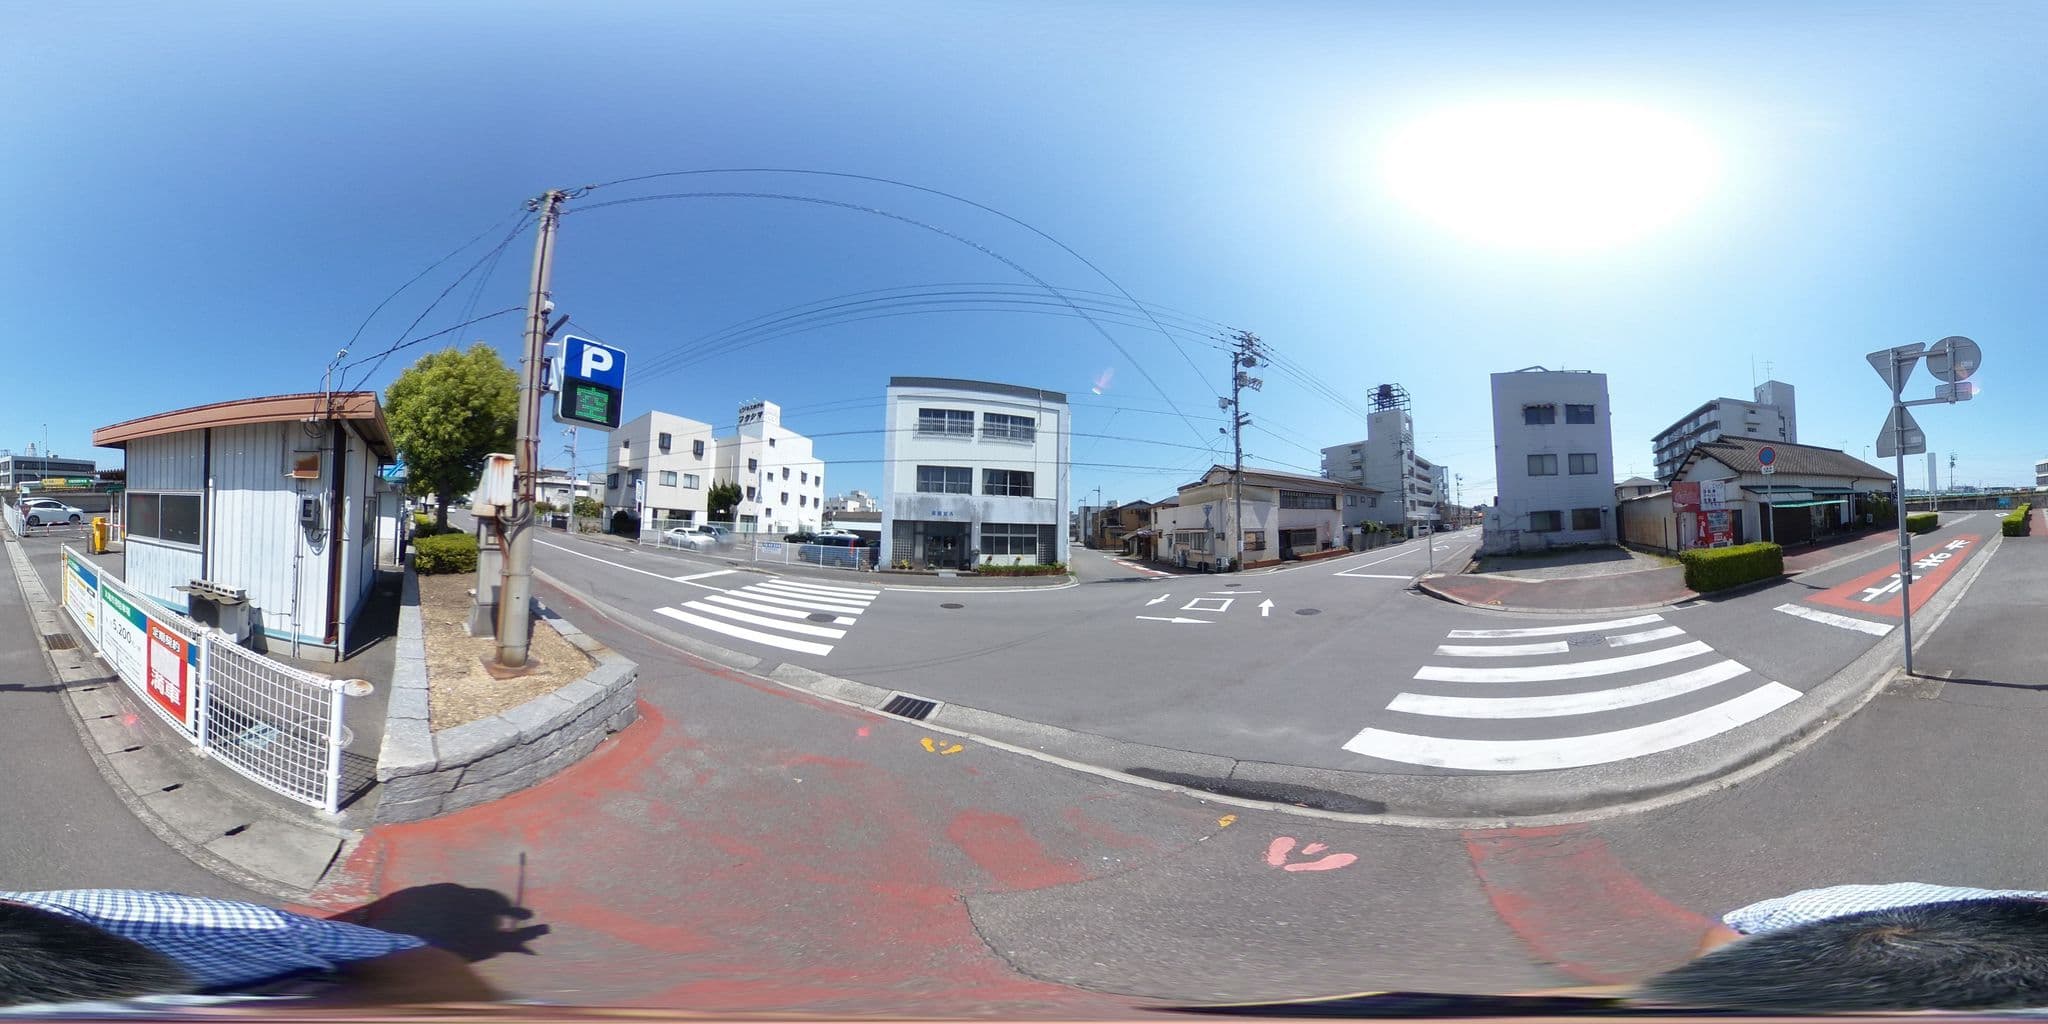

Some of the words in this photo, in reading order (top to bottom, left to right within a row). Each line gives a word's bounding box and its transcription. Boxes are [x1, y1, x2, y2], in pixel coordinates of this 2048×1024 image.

[581, 344, 613, 377] P
[1861, 539, 1971, 601] 止まれ
[152, 626, 180, 652] 定期契約
[150, 668, 181, 706] 満車
